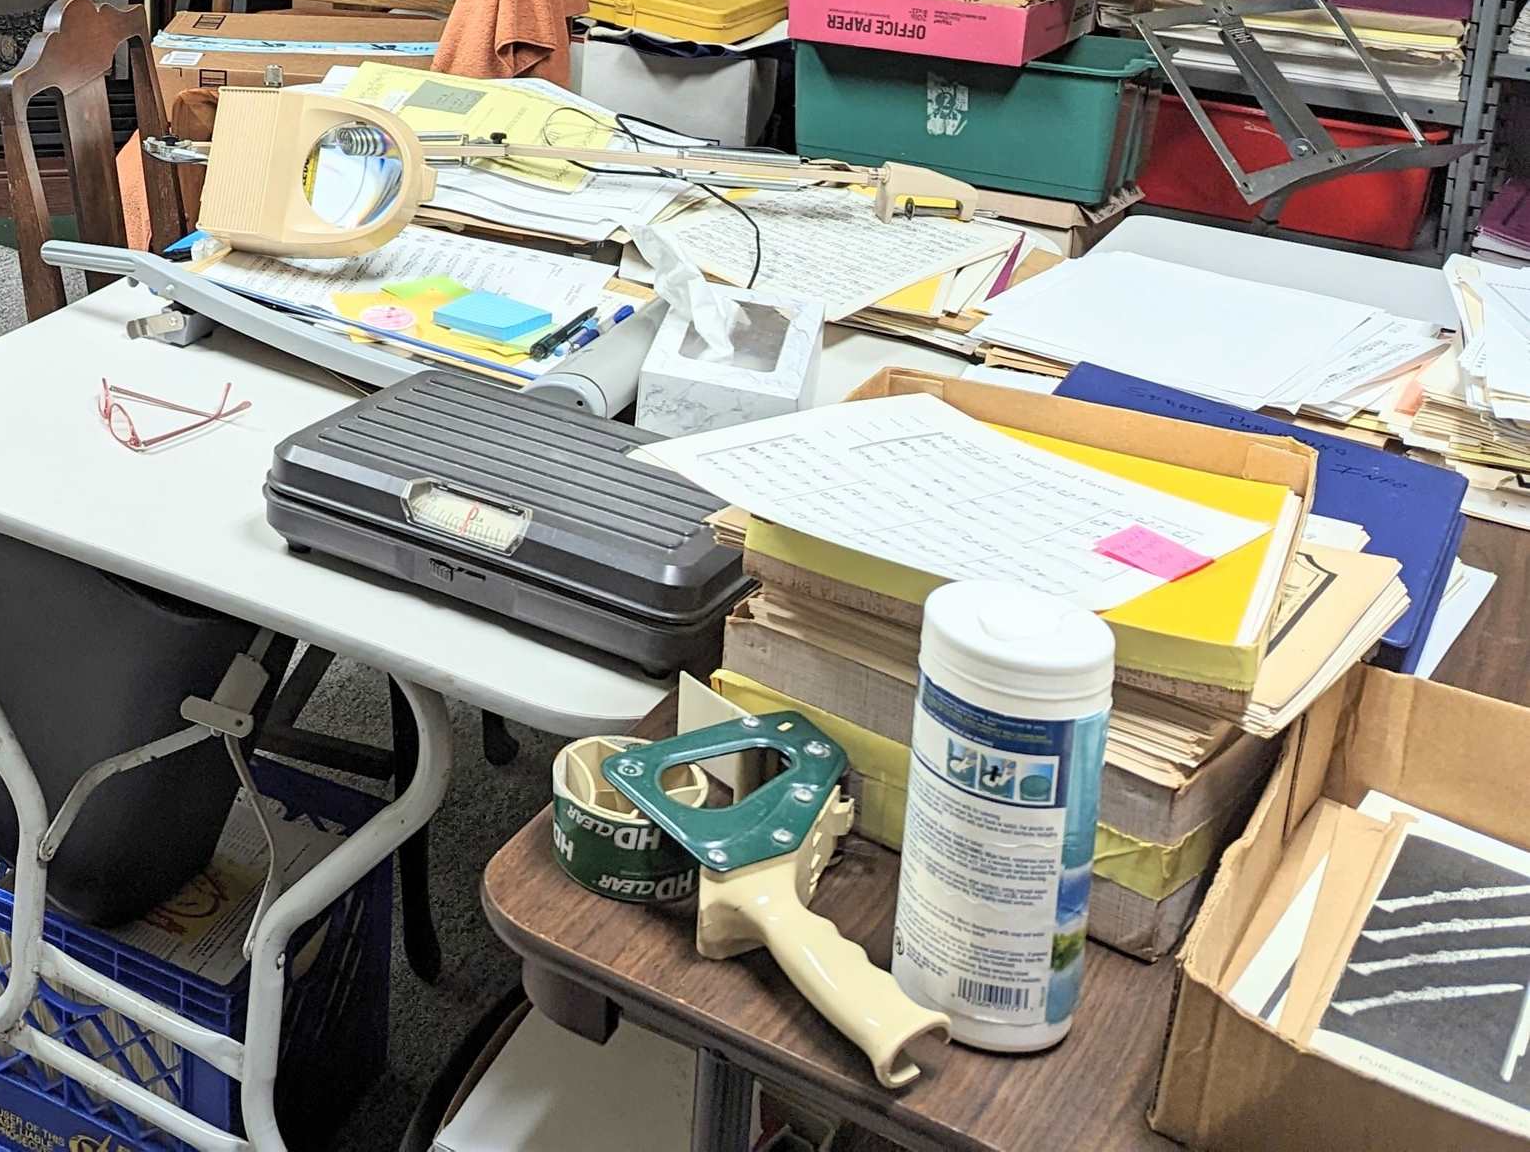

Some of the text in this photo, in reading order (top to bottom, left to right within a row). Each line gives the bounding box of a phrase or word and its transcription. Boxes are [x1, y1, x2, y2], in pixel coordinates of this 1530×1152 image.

[826, 12, 927, 41] OFFICE PAPER
[566, 805, 662, 851] HD CLEAR
[597, 868, 694, 900] HD CLEAR
[19, 1125, 54, 1149] LIABLE
[25, 1119, 40, 1133] OF
[43, 1127, 65, 1148] THIS
